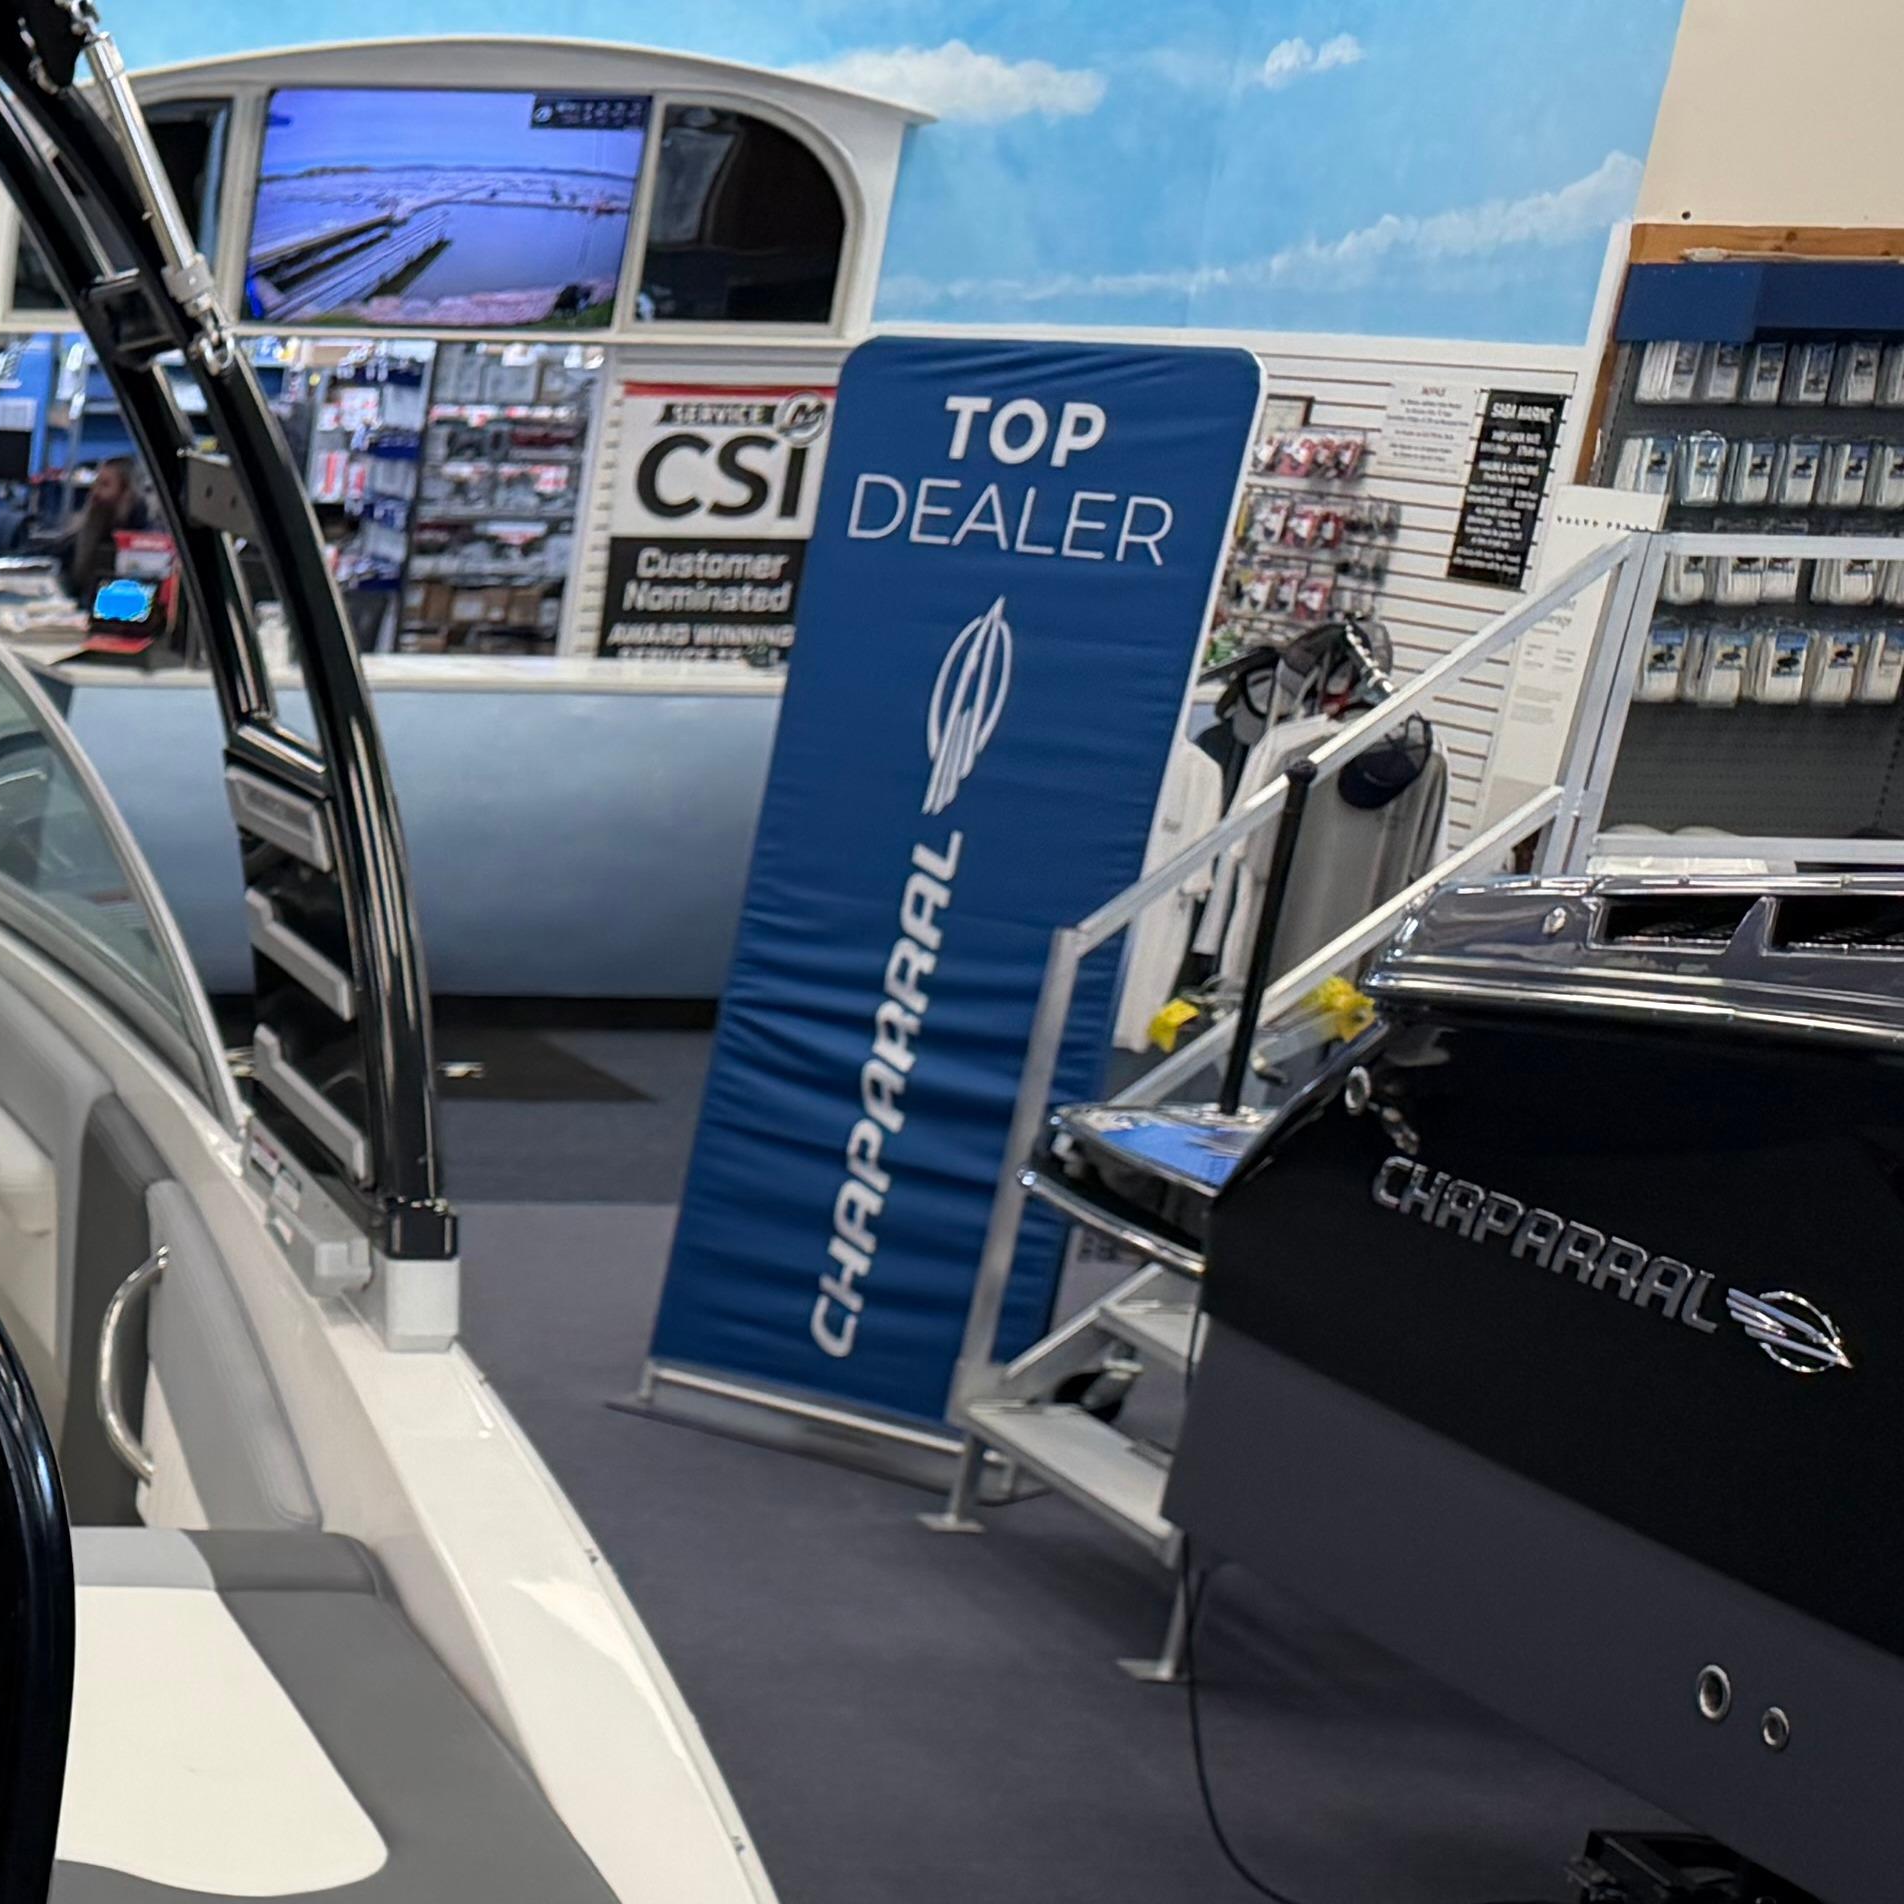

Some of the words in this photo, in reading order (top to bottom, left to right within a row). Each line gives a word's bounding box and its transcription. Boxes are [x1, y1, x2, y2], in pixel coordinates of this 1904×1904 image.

[670, 404, 766, 424] SERVICE
[944, 396, 1107, 468] TOP
[636, 433, 810, 519] CSI
[847, 472, 1175, 567] DEALER
[622, 579, 792, 612] Nominated
[637, 547, 790, 580] Customer
[811, 830, 962, 1358] CHAPARRAL
[1372, 1156, 1720, 1334] CHAPARRAL
